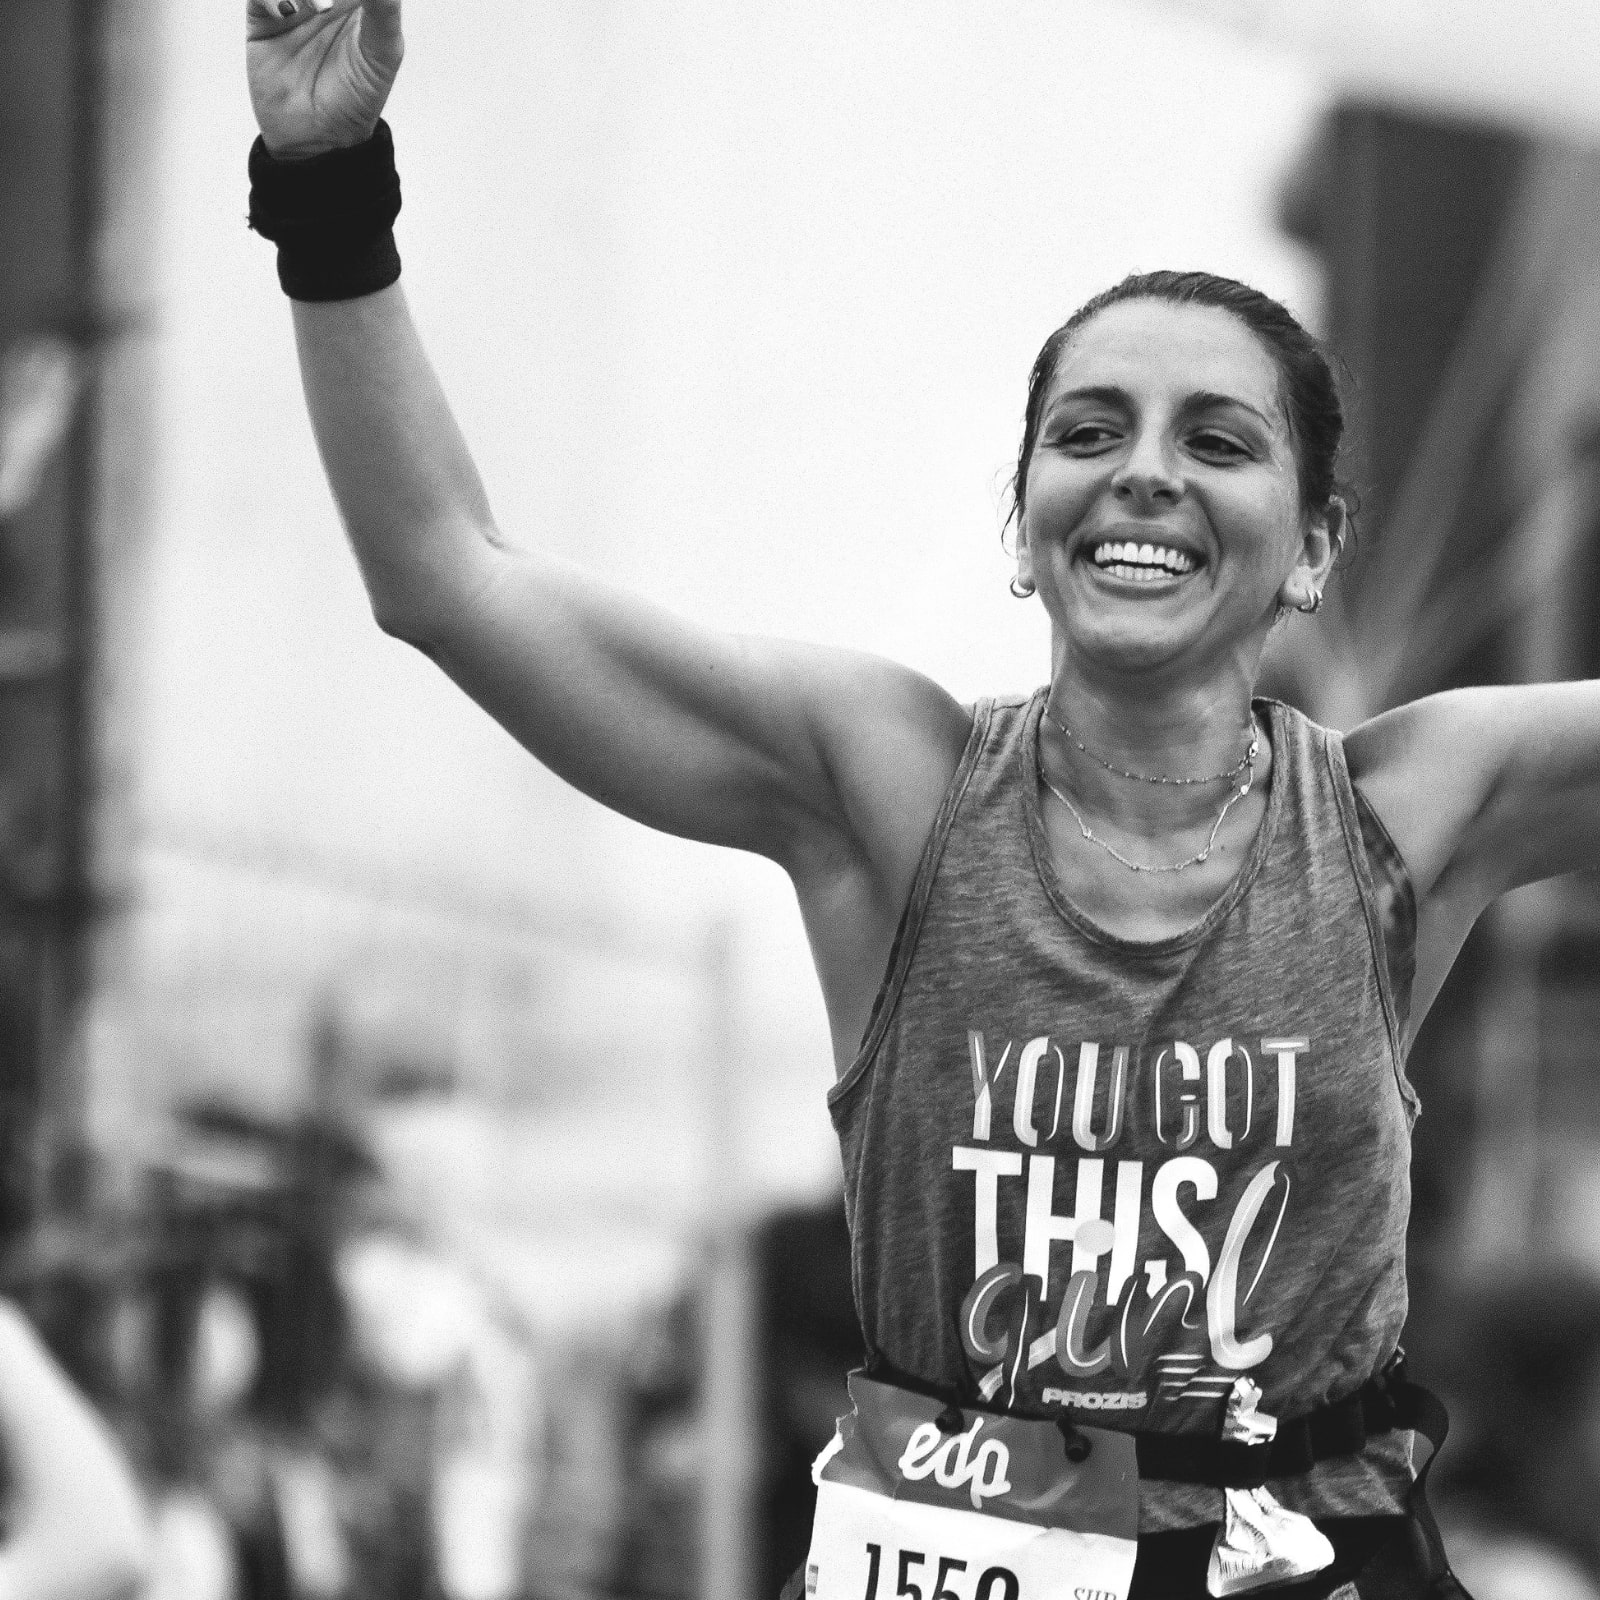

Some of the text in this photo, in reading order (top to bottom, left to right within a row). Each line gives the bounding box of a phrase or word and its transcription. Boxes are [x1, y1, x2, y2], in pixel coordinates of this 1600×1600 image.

[967, 1030, 1310, 1152] YOU GOT
[952, 1145, 1219, 1306] THIS
[959, 1160, 1291, 1408] girl
[1041, 1387, 1147, 1410] PROZIS
[898, 1416, 1012, 1509] edp
